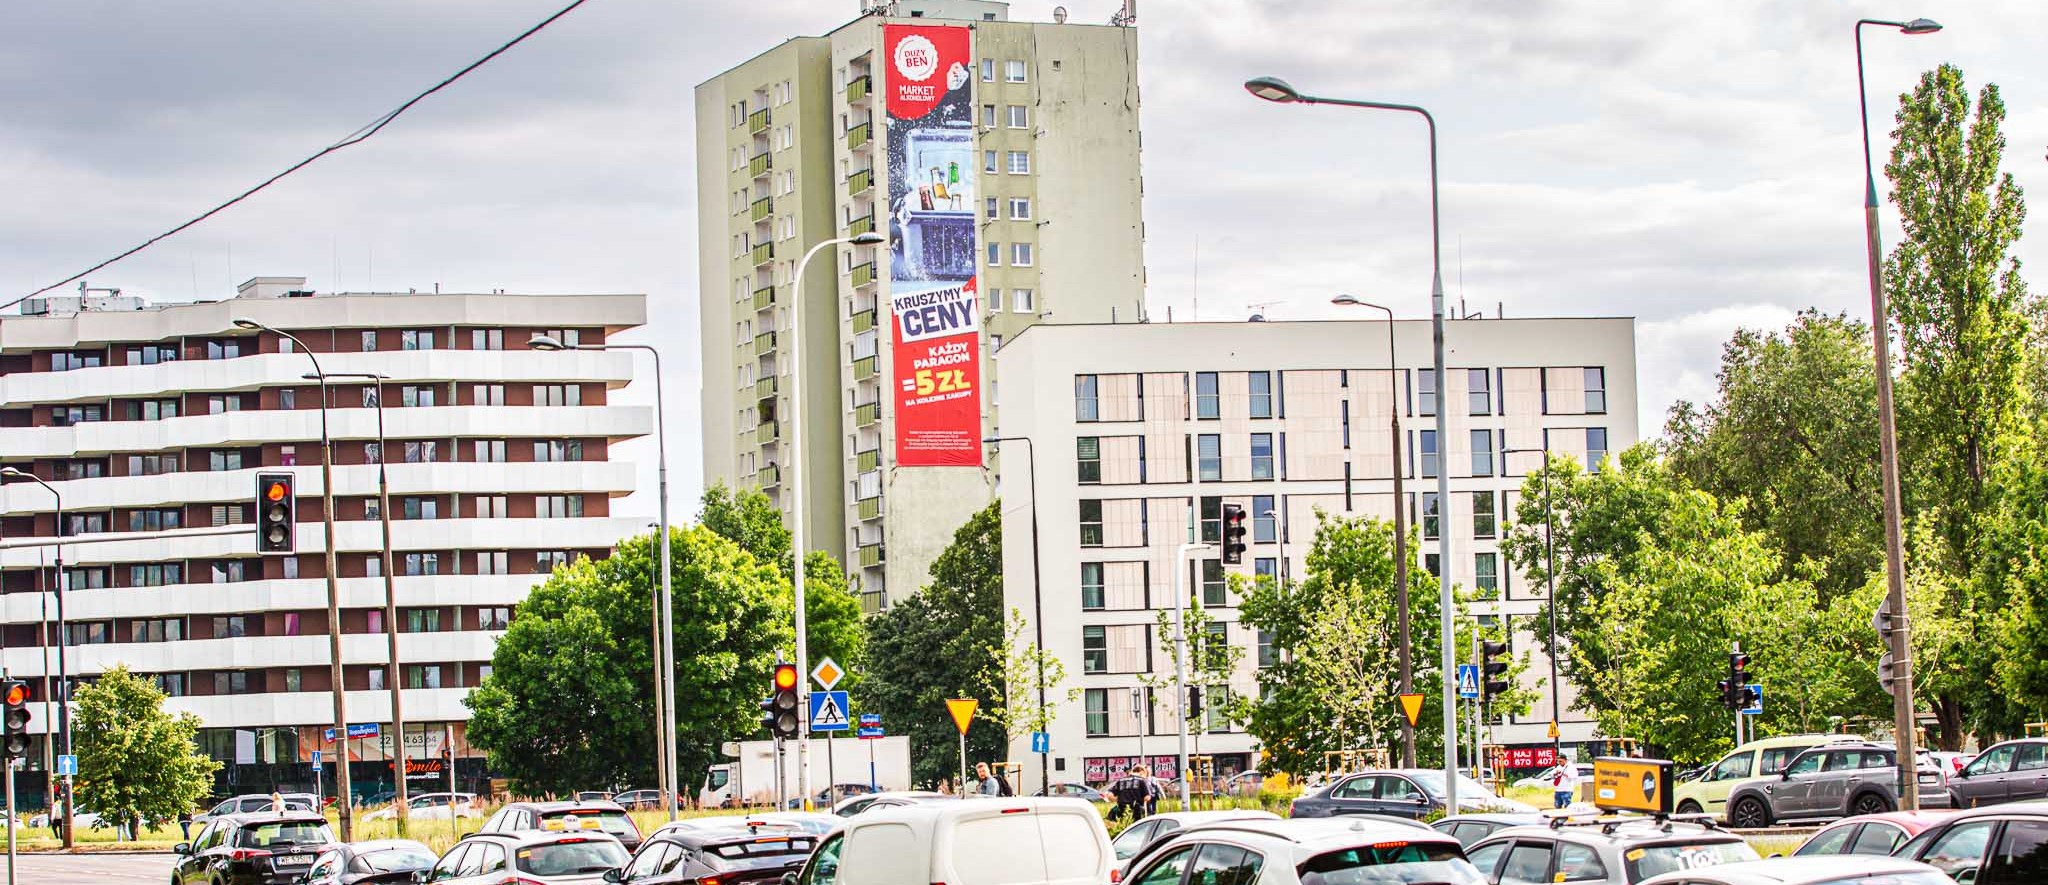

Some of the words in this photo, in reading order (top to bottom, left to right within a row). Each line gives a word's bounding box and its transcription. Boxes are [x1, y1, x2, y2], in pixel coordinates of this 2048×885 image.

[905, 57, 928, 67] BEN
[899, 85, 935, 95] MARKET
[895, 287, 961, 310] KRUSZYMY
[903, 298, 973, 336] CENY
[928, 342, 968, 357] KAŻDY
[913, 352, 970, 370] PARAGON
[411, 736, 424, 744] 63
[1513, 750, 1532, 758] NAJ
